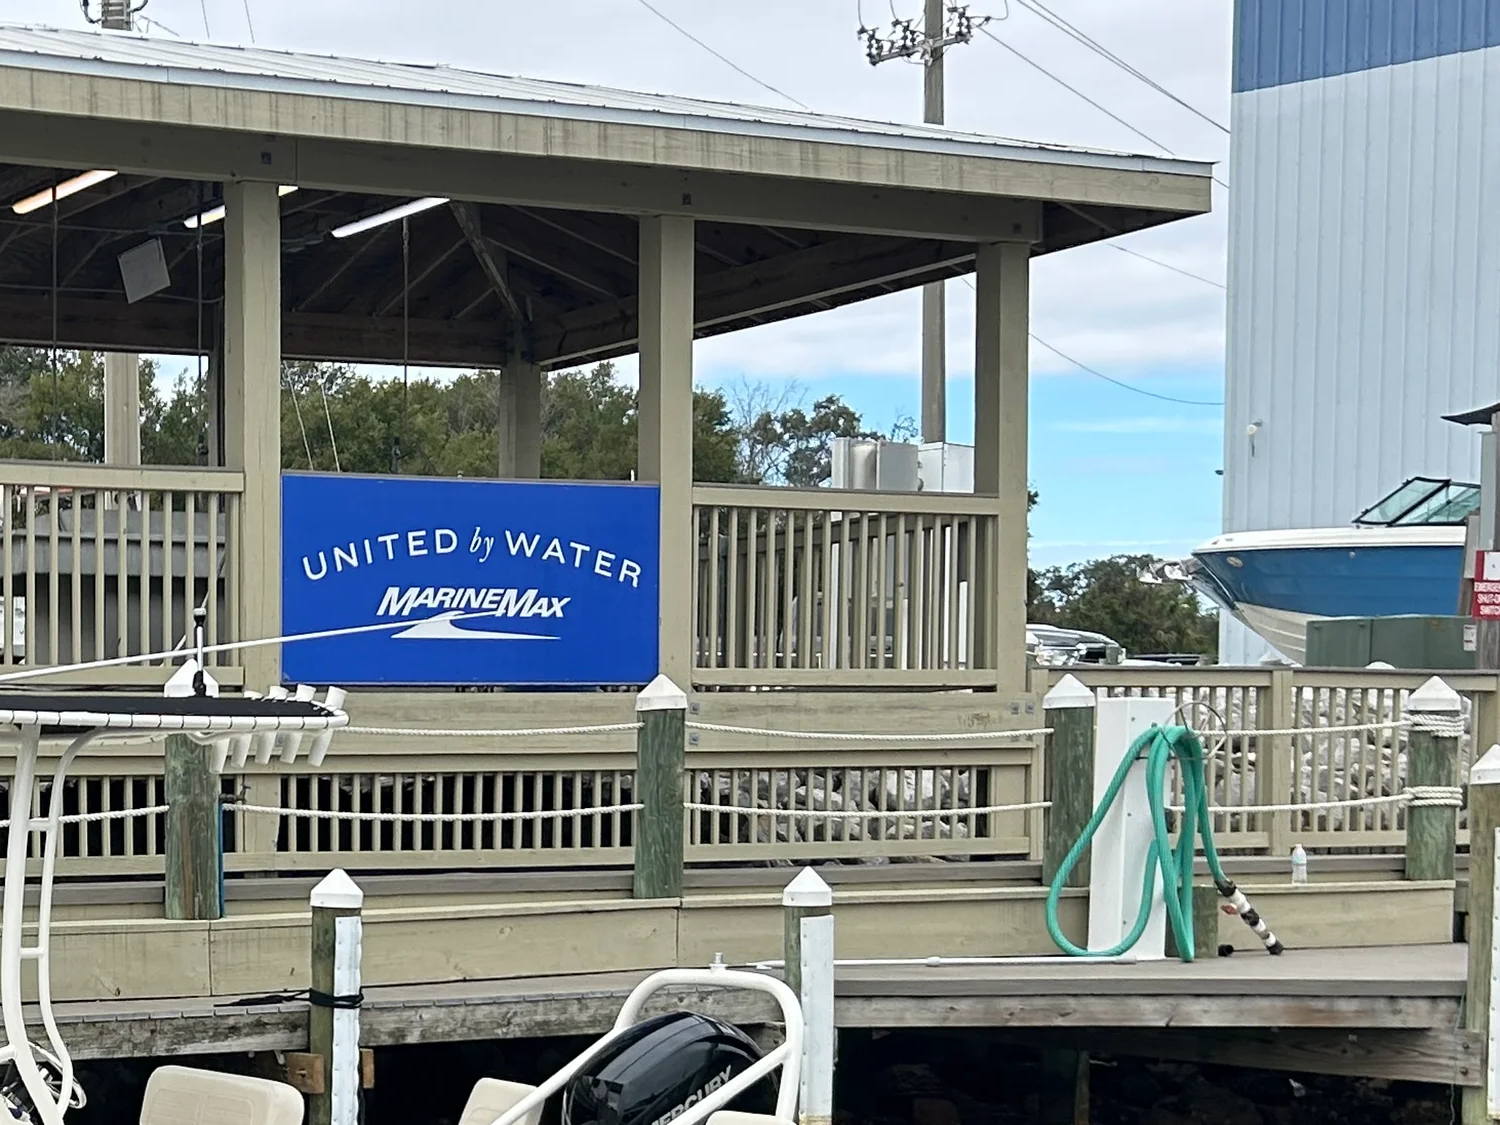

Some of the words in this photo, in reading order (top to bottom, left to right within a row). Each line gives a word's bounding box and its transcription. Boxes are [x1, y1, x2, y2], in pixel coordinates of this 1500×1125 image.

[302, 528, 459, 581] UNITED
[468, 526, 495, 563] by
[504, 529, 643, 588] WATER
